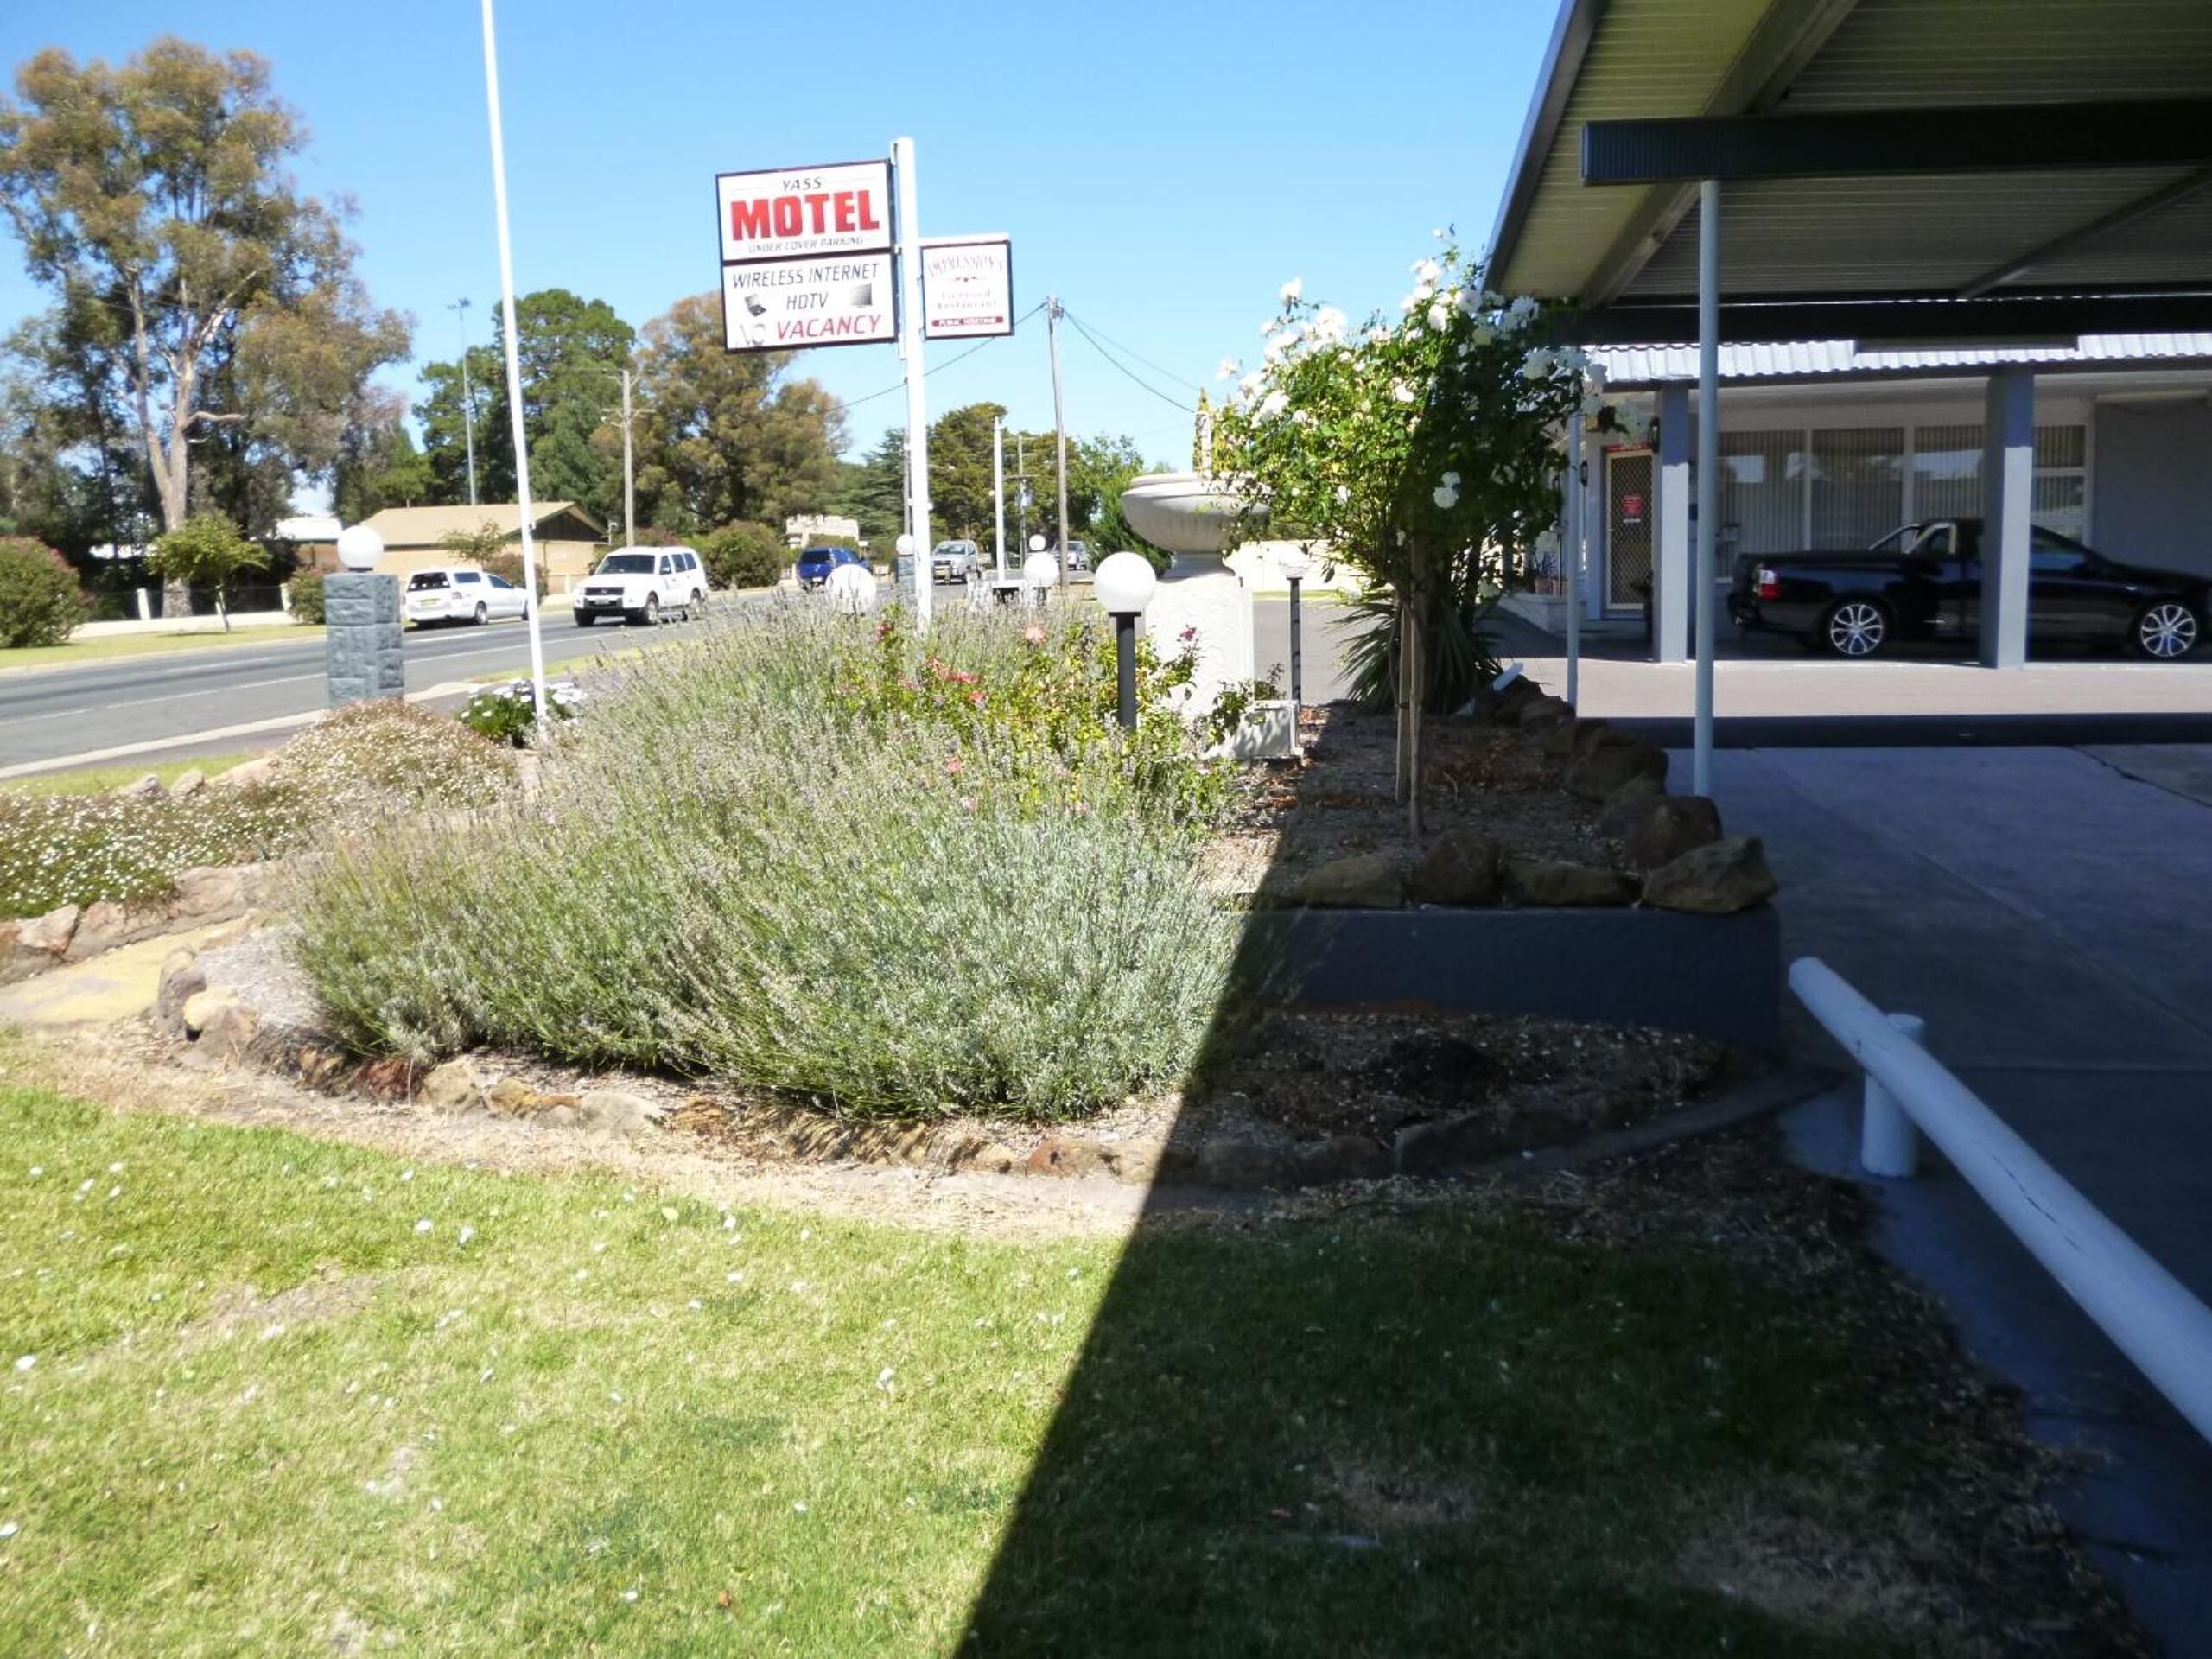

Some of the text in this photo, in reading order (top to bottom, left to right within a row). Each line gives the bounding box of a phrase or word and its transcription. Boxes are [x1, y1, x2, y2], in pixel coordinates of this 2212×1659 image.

[782, 177, 823, 191] YASS
[731, 190, 880, 241] MOTEL
[749, 235, 864, 254] UNDER COVER PARKING
[733, 263, 880, 289] WIRELESS INTERNET
[786, 293, 830, 310] HDTV
[777, 314, 882, 340] VACANCY
